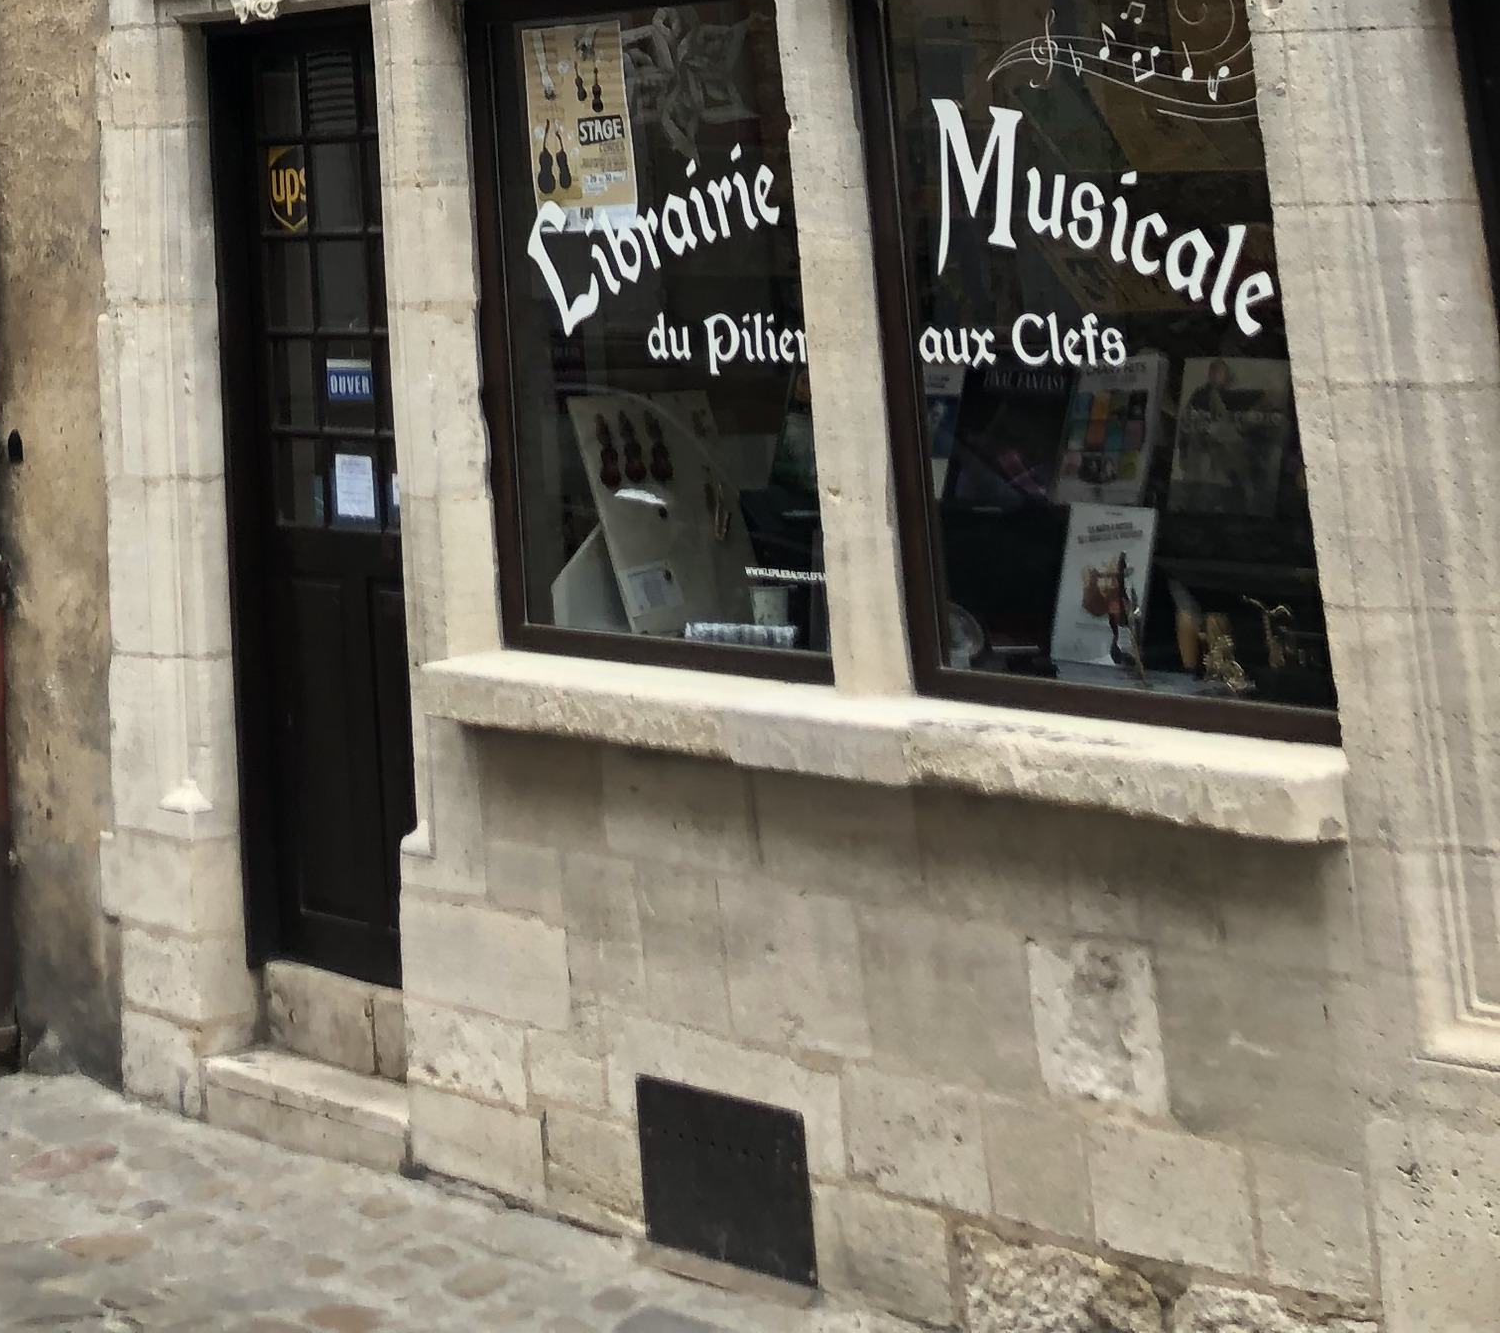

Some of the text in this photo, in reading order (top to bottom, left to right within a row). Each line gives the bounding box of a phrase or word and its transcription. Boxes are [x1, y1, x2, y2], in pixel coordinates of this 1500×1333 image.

[579, 118, 623, 142] STAGE
[526, 97, 1275, 336] Librairie Musicale
[648, 311, 692, 361] du
[918, 322, 997, 367] aux
[1011, 313, 1129, 368] Clefs
